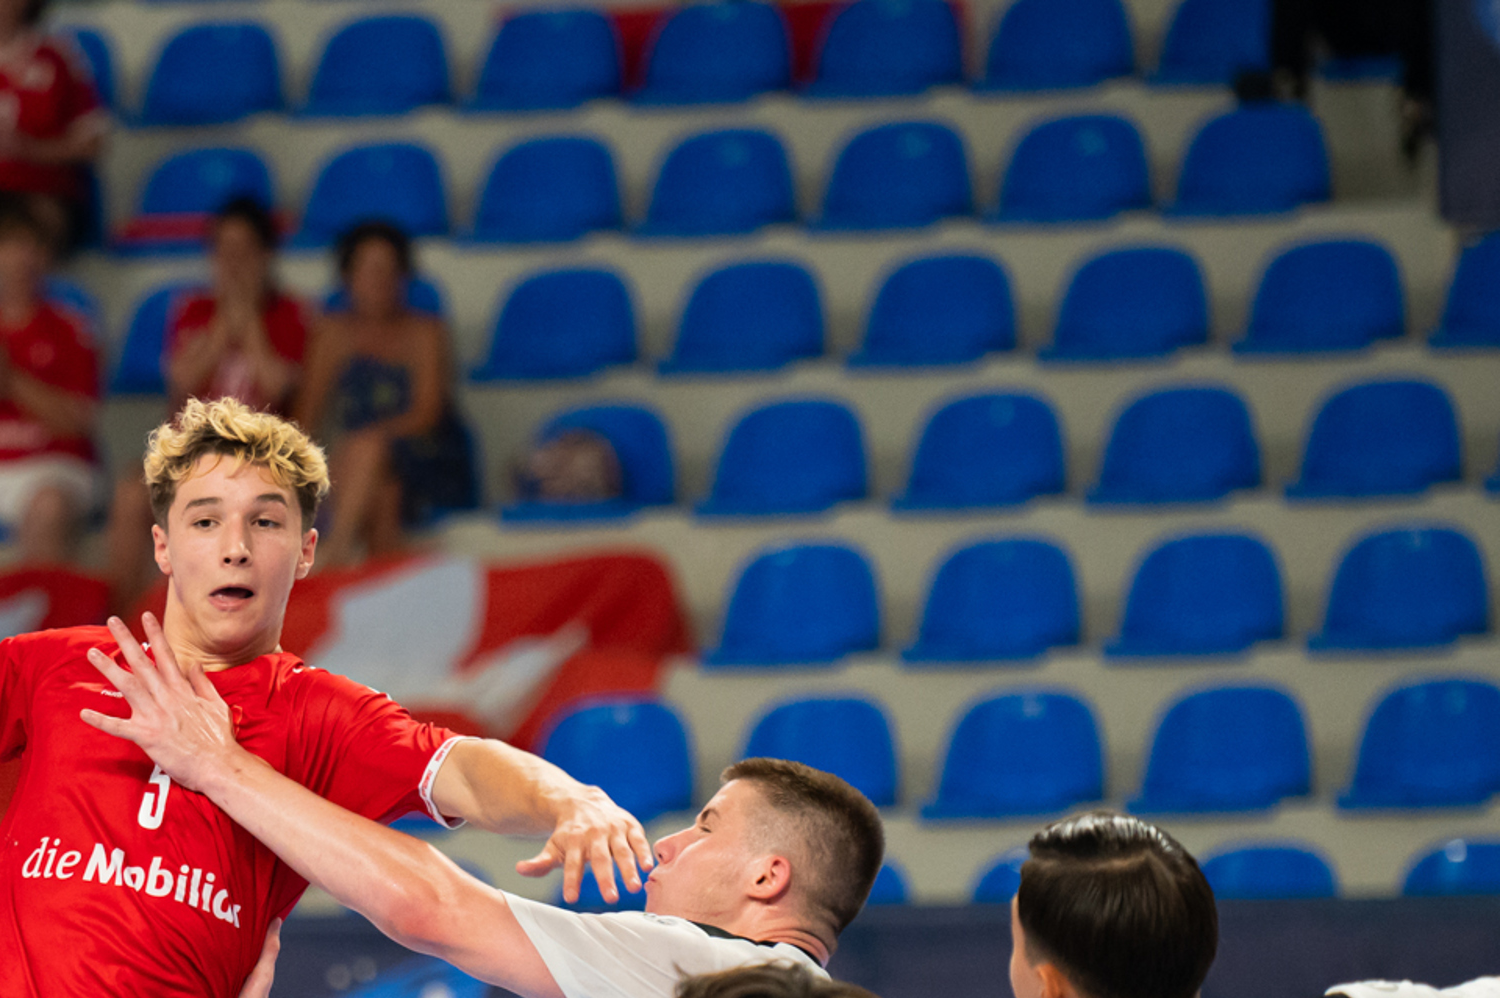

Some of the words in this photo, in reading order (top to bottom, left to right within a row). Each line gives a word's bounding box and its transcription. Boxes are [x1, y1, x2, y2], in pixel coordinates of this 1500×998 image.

[138, 763, 171, 829] 5
[21, 836, 81, 880] die
[82, 842, 241, 928] Mobiliar
